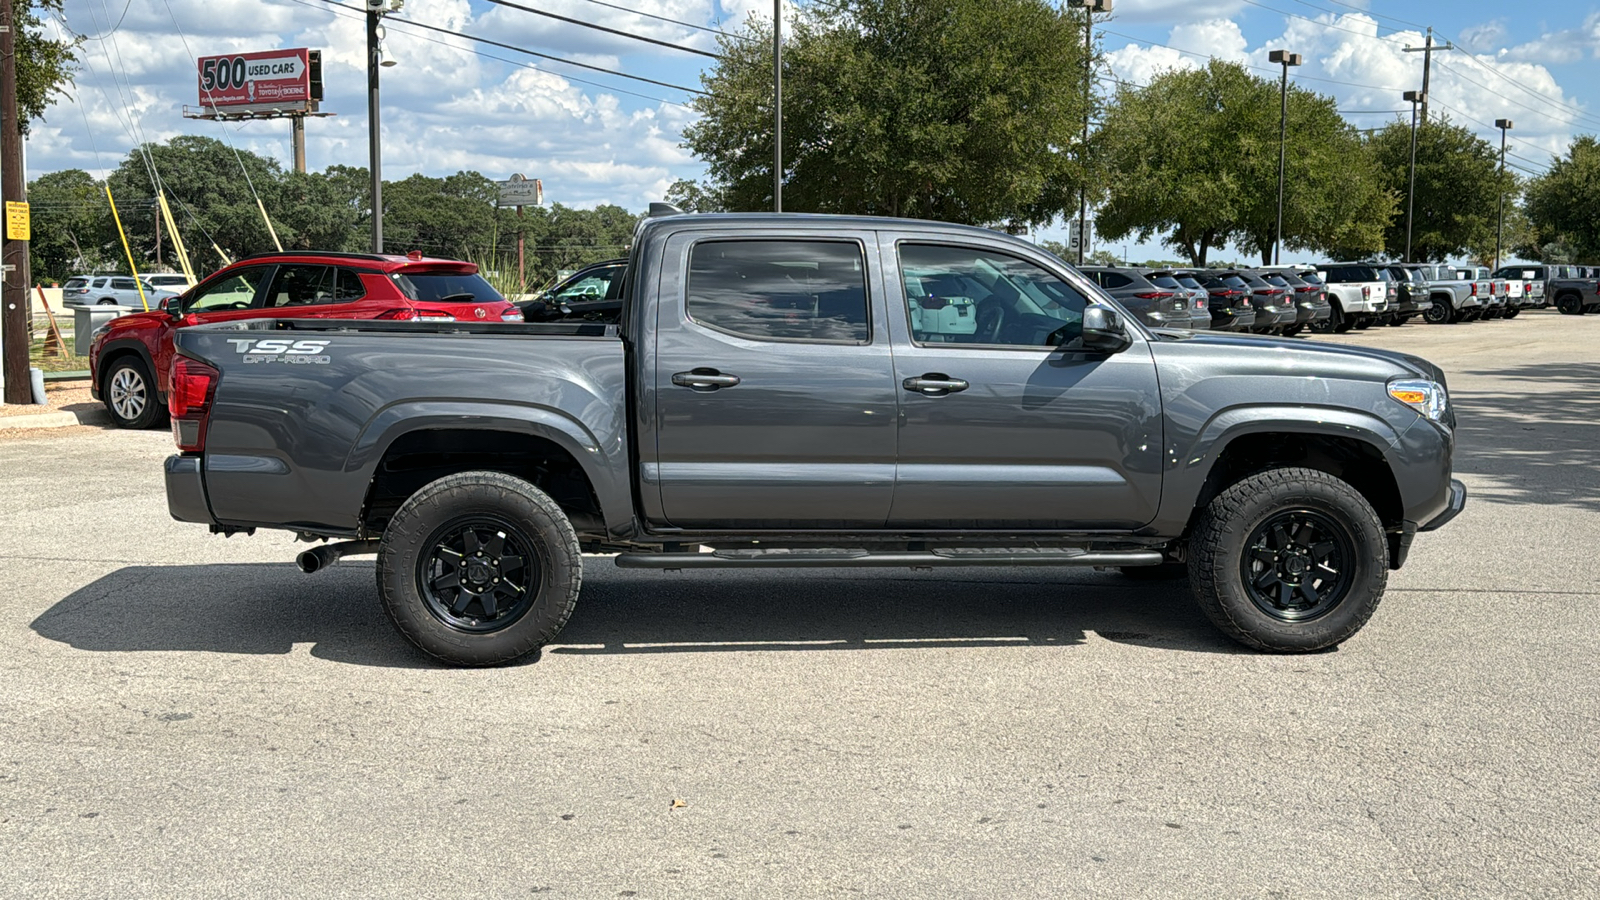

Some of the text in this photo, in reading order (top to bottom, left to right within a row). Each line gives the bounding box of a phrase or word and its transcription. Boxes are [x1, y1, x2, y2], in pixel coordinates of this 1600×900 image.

[201, 56, 246, 91] 500
[249, 65, 270, 76] USED
[273, 63, 294, 75] CARS
[258, 88, 278, 96] TOYOTA
[227, 339, 331, 354] TSS
[243, 355, 331, 364] OFF-ROAD
